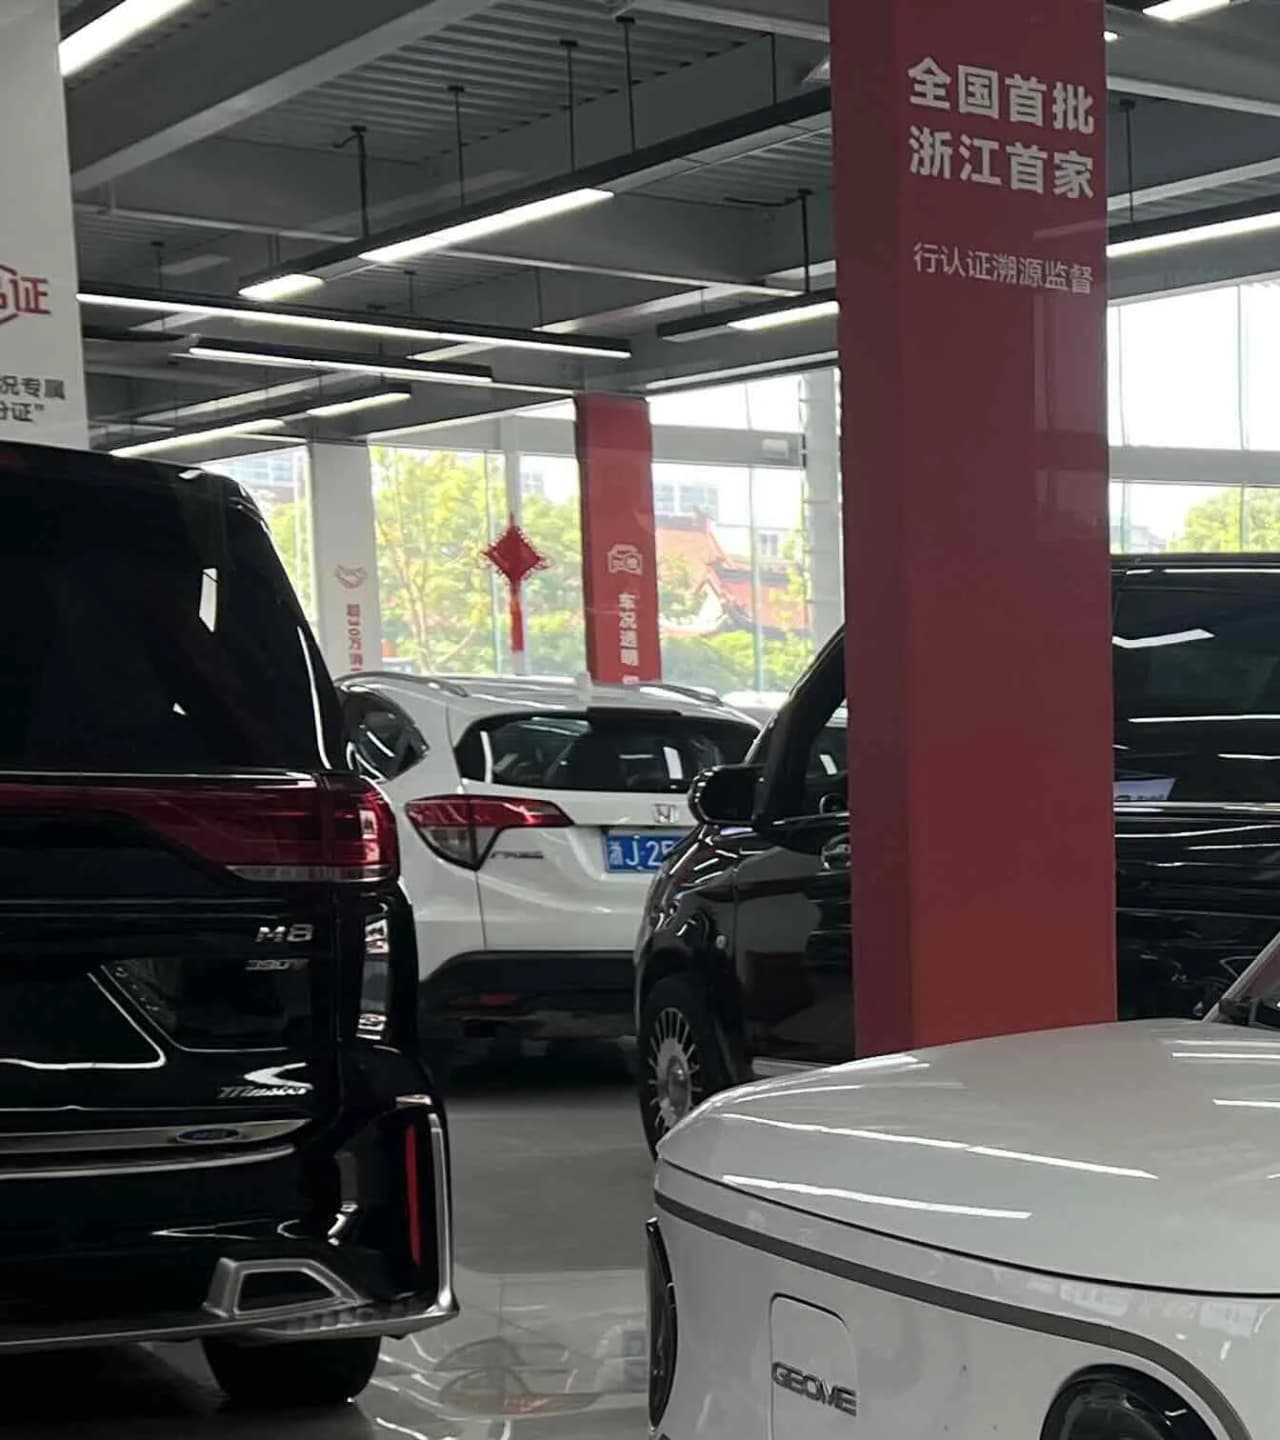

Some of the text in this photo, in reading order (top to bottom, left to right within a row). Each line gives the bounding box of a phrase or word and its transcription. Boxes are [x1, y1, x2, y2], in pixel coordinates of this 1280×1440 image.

[907, 56, 1095, 135] 全国首批
[908, 125, 1095, 200] 浙江首家
[913, 241, 1094, 294] 行认证溯源监督
[0, 277, 52, 315] 证
[256, 923, 313, 942] M8
[771, 1361, 857, 1418] GEOME
